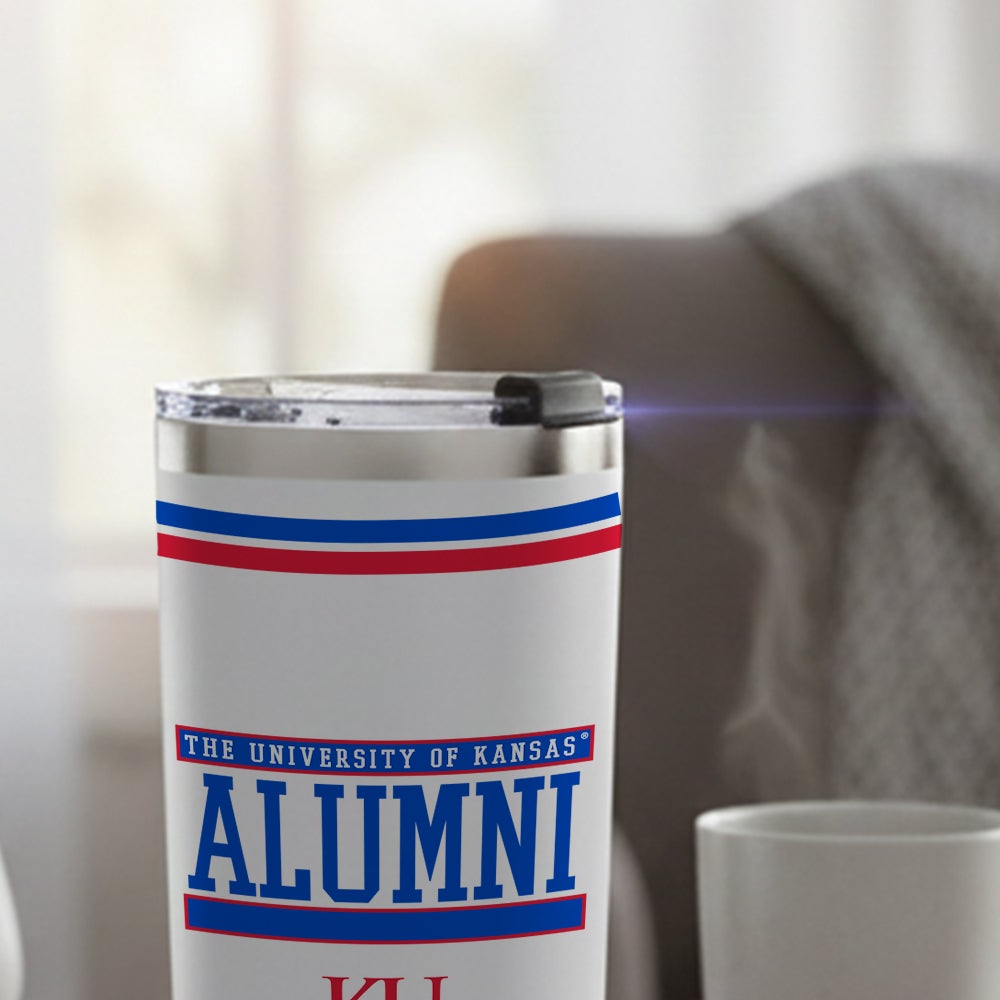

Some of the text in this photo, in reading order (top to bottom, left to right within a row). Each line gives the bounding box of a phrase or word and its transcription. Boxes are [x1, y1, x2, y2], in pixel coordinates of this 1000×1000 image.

[184, 734, 234, 760] THE
[249, 742, 415, 769] UNIVERSITY
[430, 747, 459, 768] OF
[187, 770, 581, 904] ALUMNI
